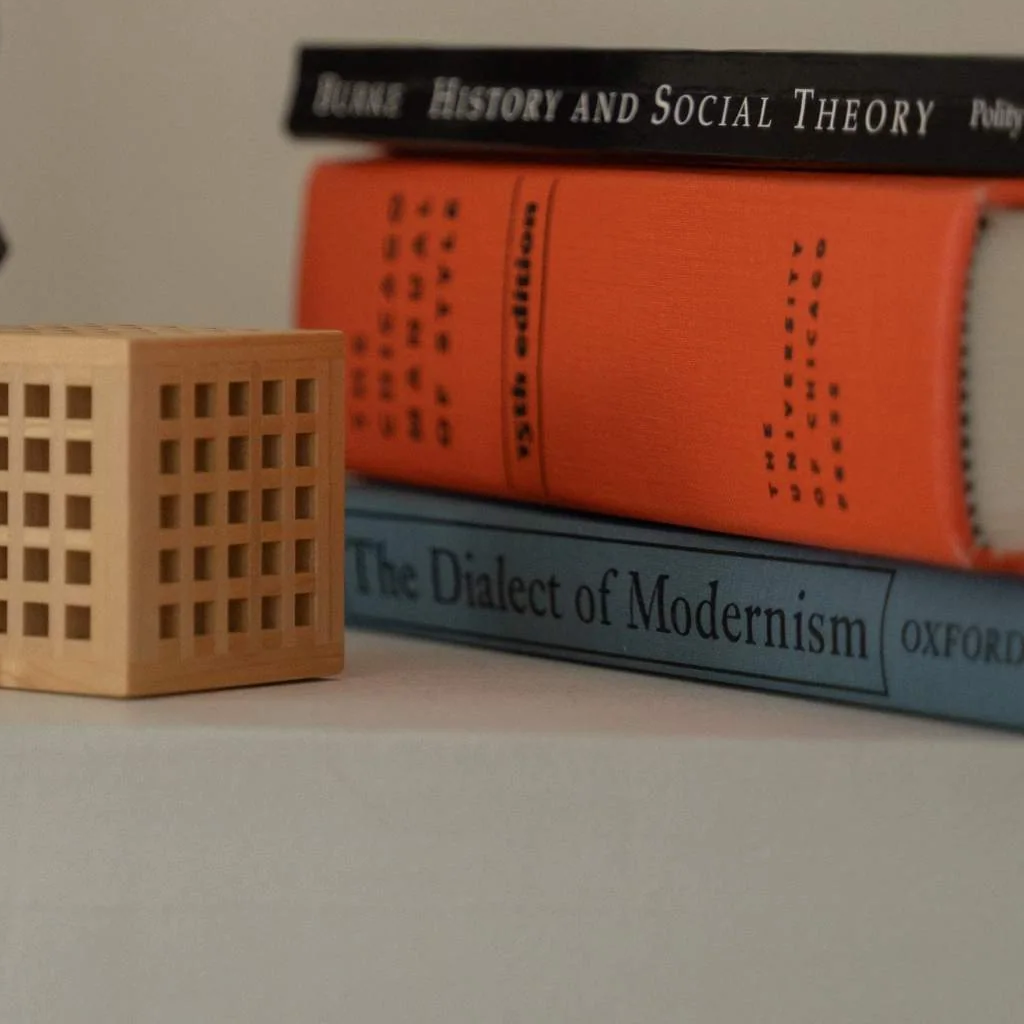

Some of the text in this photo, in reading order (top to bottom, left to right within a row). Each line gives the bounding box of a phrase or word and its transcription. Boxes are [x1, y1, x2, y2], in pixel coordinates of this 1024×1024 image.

[512, 201, 538, 358] edition
[806, 238, 826, 429] CHICAGO
[783, 240, 803, 502] UNIVERSITY
[763, 423, 778, 499] THE
[347, 537, 869, 660] The Dialect of Modernism
[901, 619, 1024, 664] OXFORD
